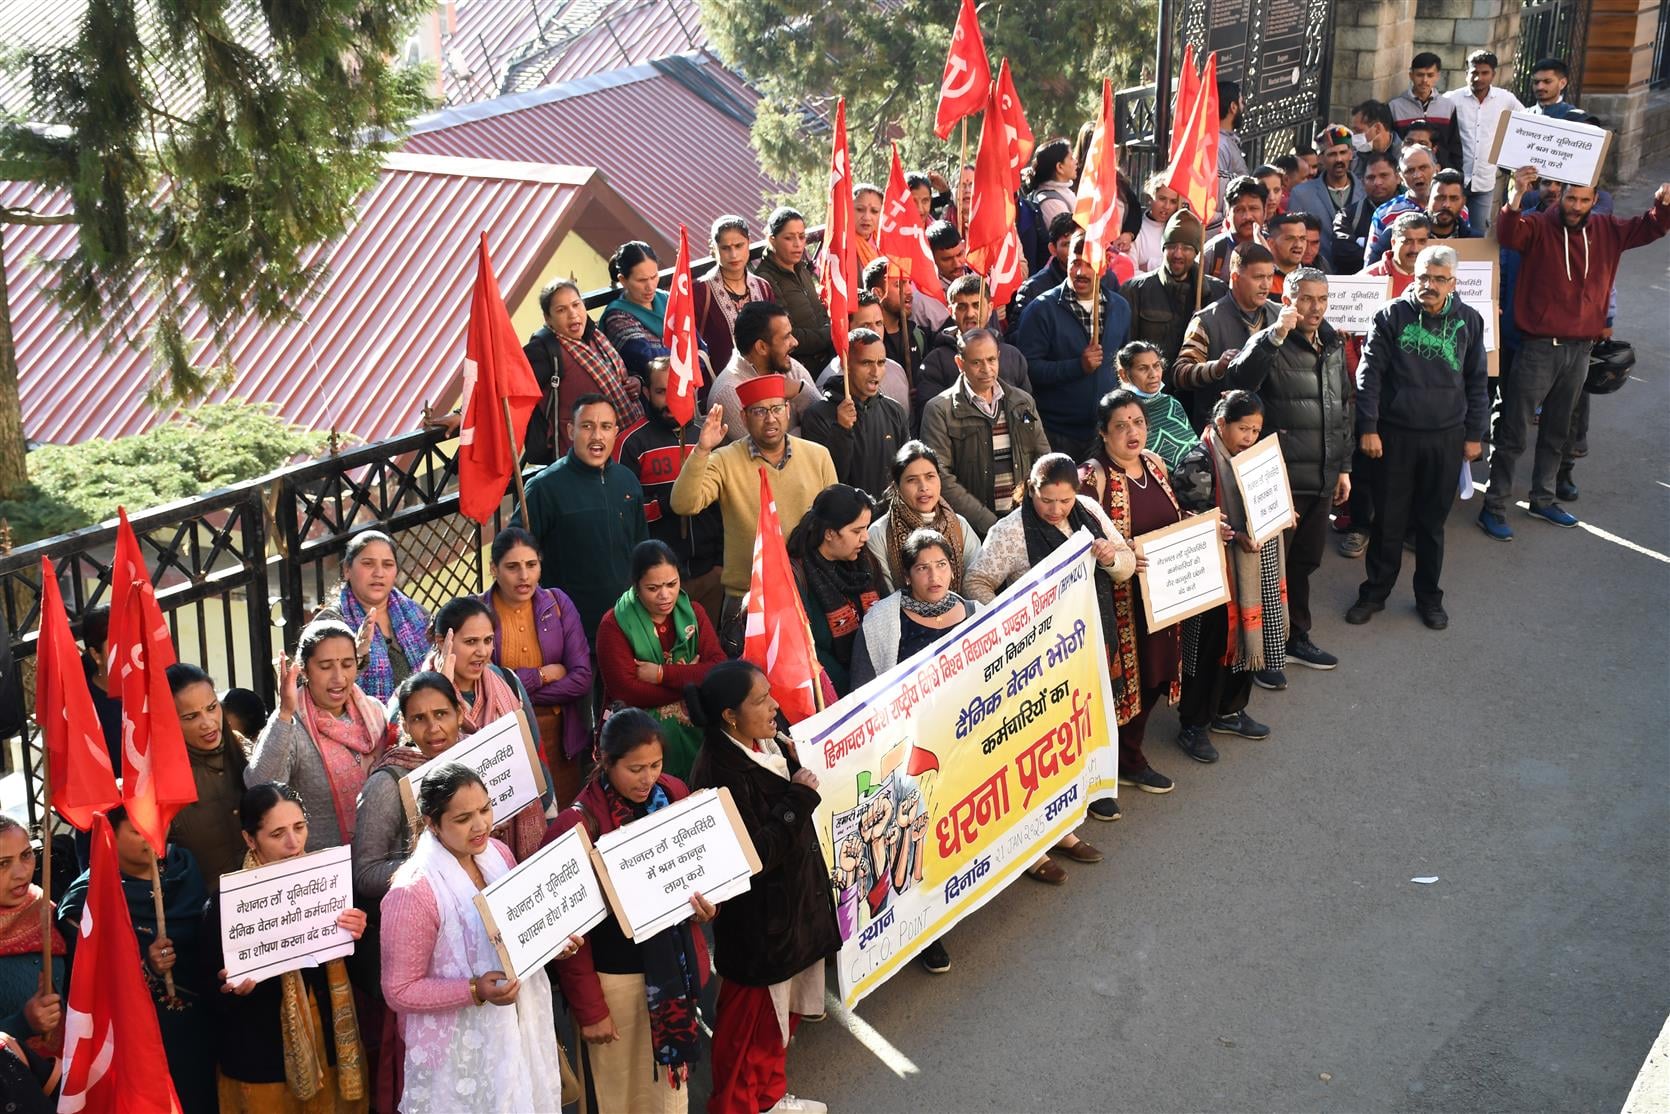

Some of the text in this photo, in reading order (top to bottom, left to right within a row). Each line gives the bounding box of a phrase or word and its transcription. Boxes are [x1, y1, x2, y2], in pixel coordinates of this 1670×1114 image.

[651, 456, 673, 476] 03
[984, 614, 1053, 683] द्वारा निकाले गए
[824, 728, 867, 769] हिमाचल
[864, 703, 890, 743] प्रदेश
[940, 650, 964, 689] विश्व
[1031, 583, 1058, 619] शिमला
[955, 618, 1086, 740] दैनिक वेतन भोगी
[981, 680, 1070, 755] कर्मचारियों का
[489, 768, 512, 786] फायर
[498, 785, 514, 802] करो
[935, 763, 1008, 859] धरना
[1044, 783, 1078, 821] समय
[619, 814, 717, 873] नेशनल लॉ यूनिवर्सिटी
[647, 844, 707, 882] में श्रम कानून
[236, 874, 339, 915] नेशनल लॉ यूनिवर्सिटी में
[505, 858, 581, 923] नेशनल लॉ यूनिवर्सिटी
[663, 865, 707, 897] लागू करो
[945, 855, 992, 905] दिनांक
[228, 895, 347, 941] दैनिक वेतन भोगी कर्मचारियों
[517, 914, 547, 949] प्रशासन
[546, 901, 563, 929] होश
[562, 894, 572, 913] में
[569, 883, 588, 909] आओ
[858, 905, 895, 950] स्थान
[900, 906, 932, 947] POINT
[238, 948, 251, 961] का
[253, 940, 279, 958] शोषण
[280, 933, 305, 949] करना
[321, 920, 338, 937] करो
